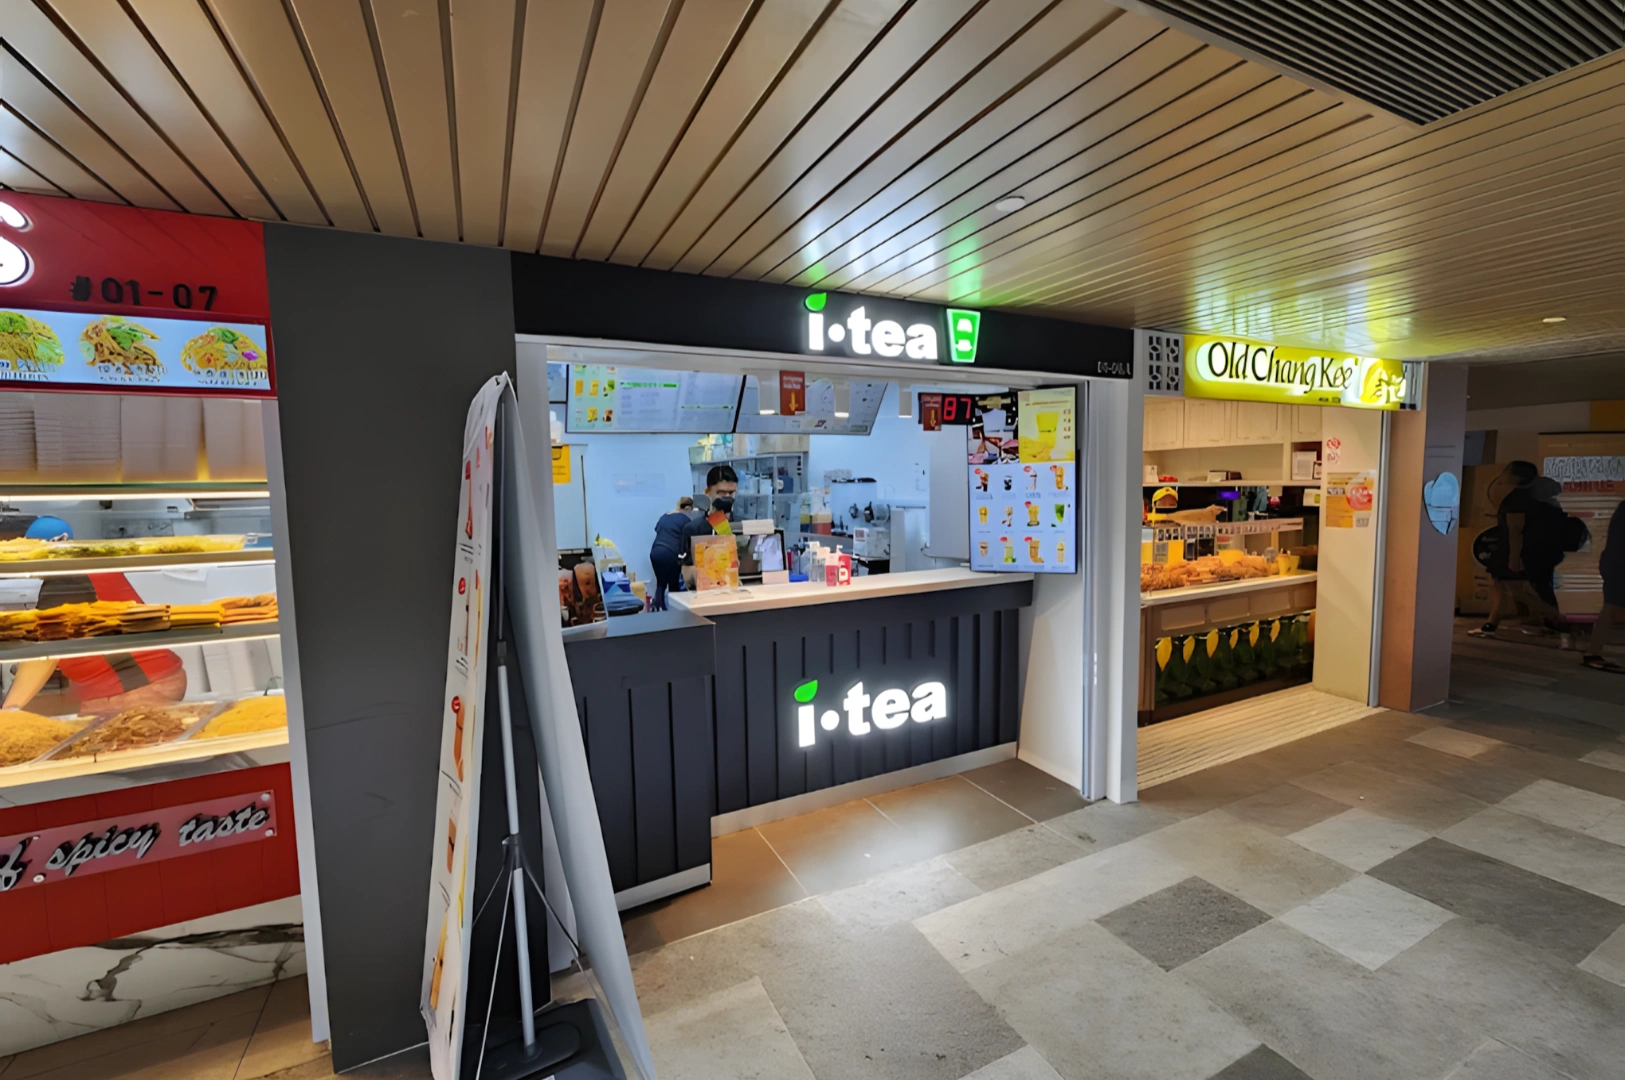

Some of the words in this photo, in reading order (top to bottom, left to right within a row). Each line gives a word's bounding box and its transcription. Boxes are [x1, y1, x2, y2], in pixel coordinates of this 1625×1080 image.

[1208, 342, 1250, 379] Old
[1251, 346, 1317, 394] Chang
[45, 824, 159, 876] spicy
[178, 803, 268, 846] taste
